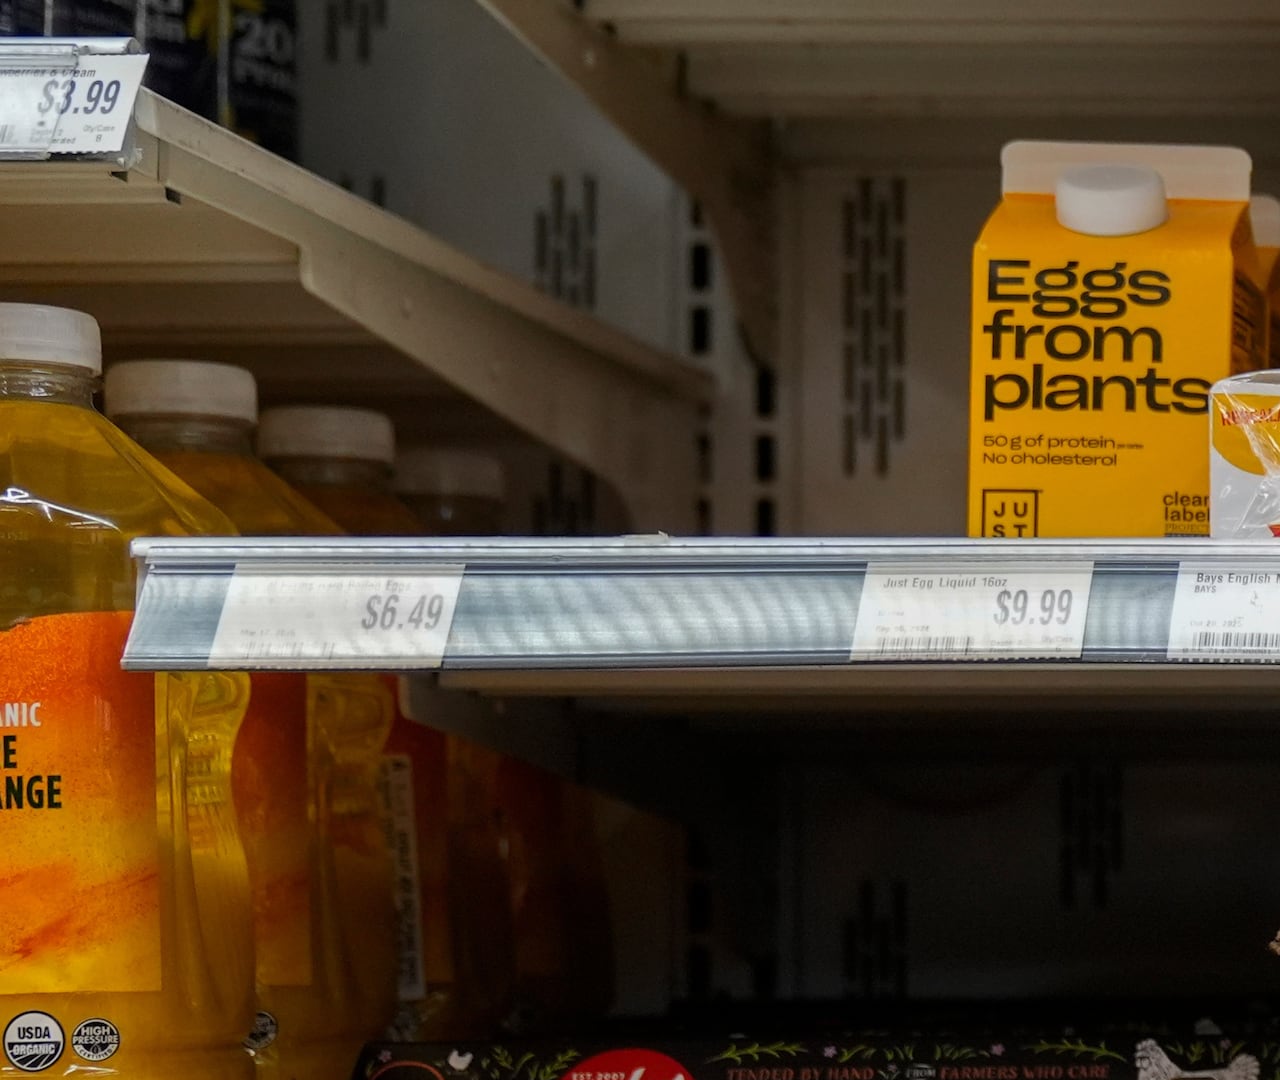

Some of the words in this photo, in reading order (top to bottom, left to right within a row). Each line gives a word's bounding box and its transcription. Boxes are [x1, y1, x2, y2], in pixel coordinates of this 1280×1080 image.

[37, 79, 121, 116] $3.99
[988, 260, 1171, 319] Eggs
[982, 309, 1163, 363] from
[984, 364, 1210, 422] plants
[1025, 435, 1044, 448] of
[1048, 436, 1116, 450] protein
[983, 453, 1007, 464] No
[1011, 453, 1117, 466] cholesterol
[883, 578, 908, 589] Just
[912, 577, 934, 590] Egg
[939, 577, 977, 590] Liquid
[982, 578, 1008, 588] 16oz
[1196, 572, 1223, 585] Bays
[1227, 573, 1271, 586] English
[1194, 585, 1217, 593] BAYS
[361, 594, 445, 630] $6.49
[994, 589, 1073, 625] $9.99
[17, 1026, 52, 1040] USDA
[81, 1026, 110, 1037] HIGH
[72, 1035, 119, 1045] PRESSURE
